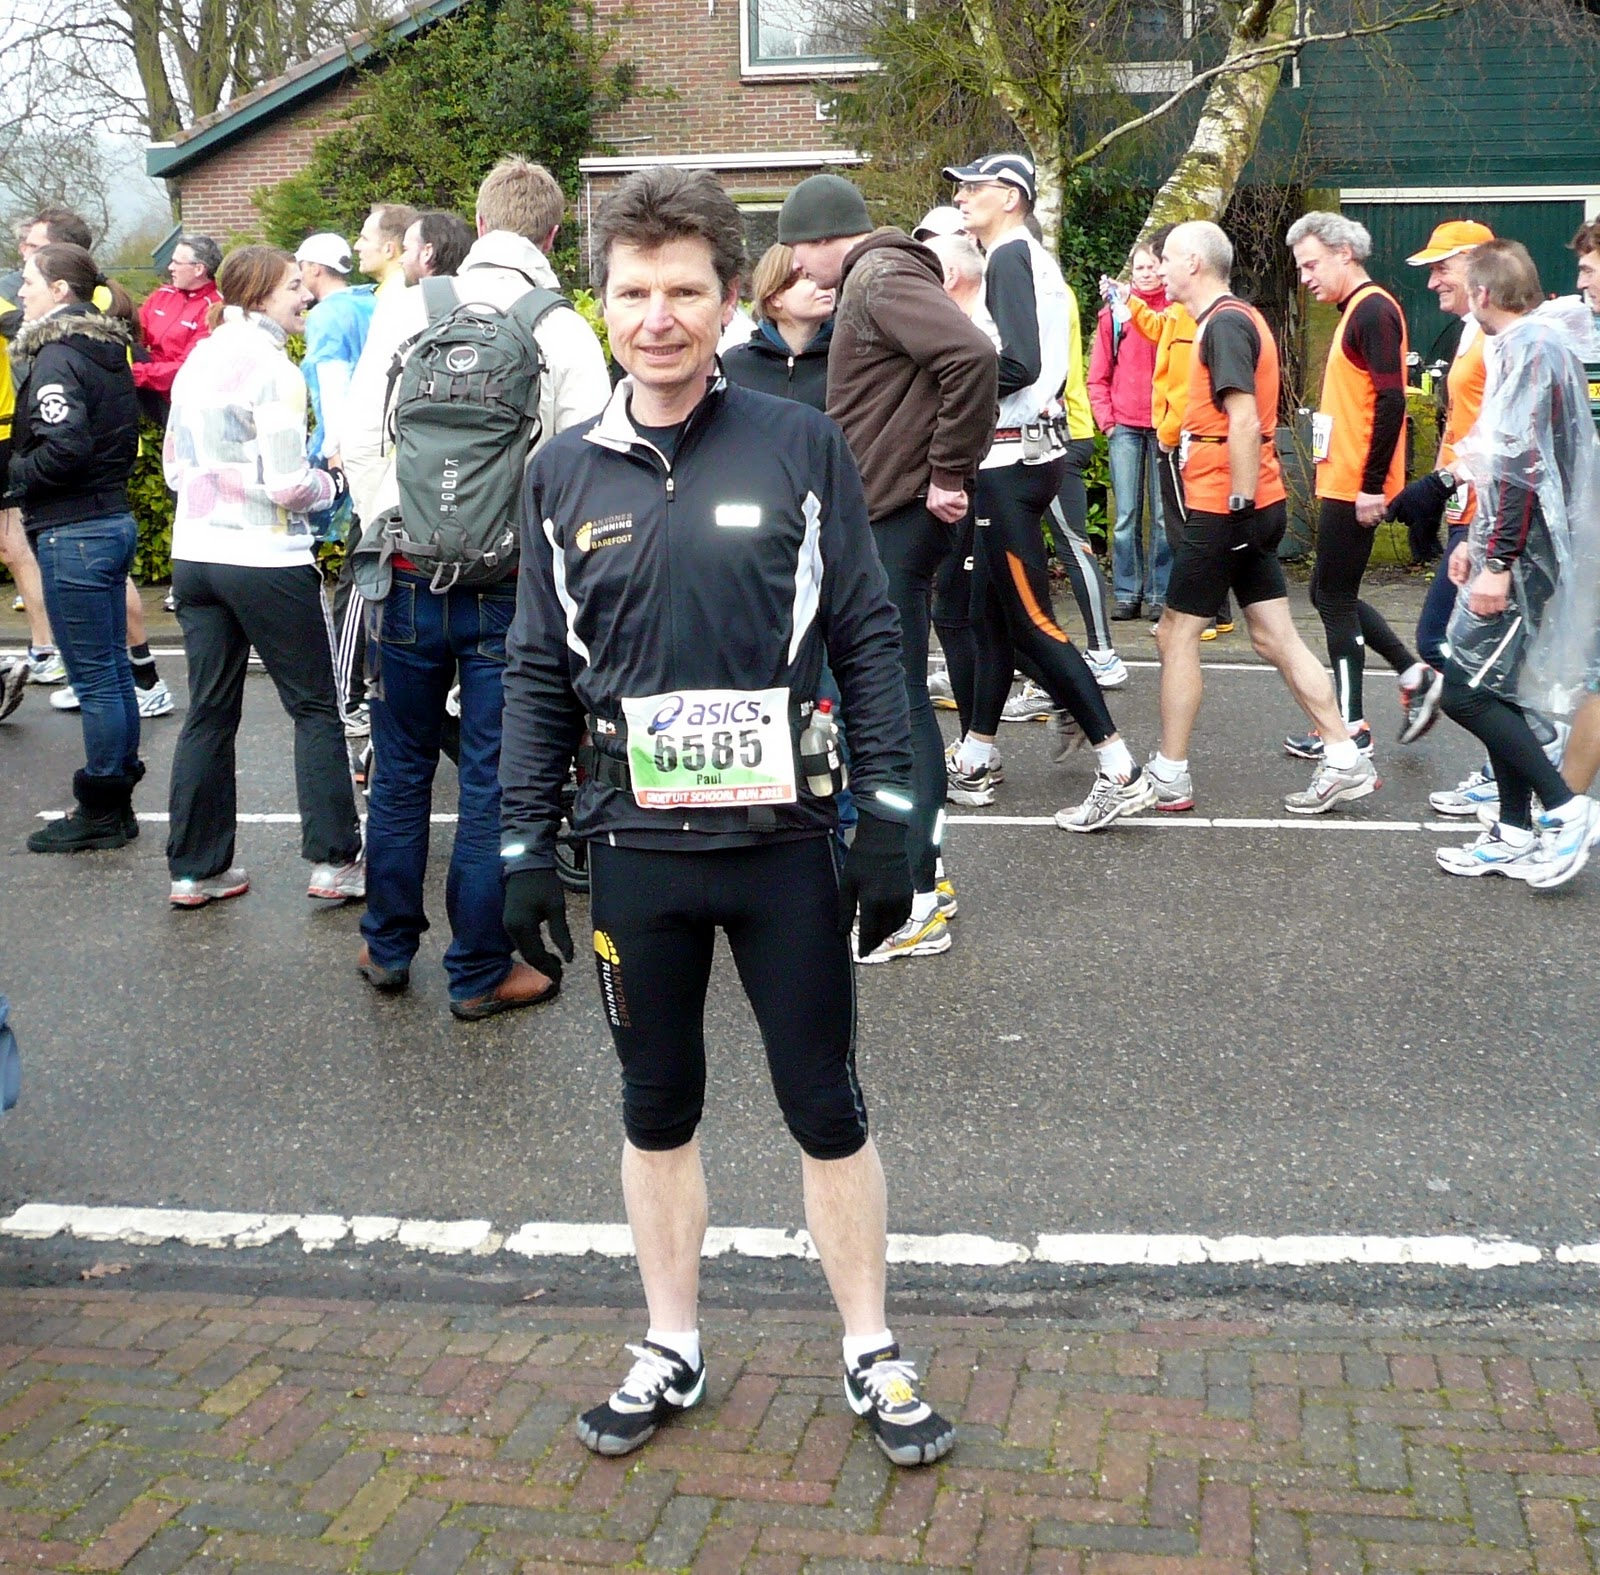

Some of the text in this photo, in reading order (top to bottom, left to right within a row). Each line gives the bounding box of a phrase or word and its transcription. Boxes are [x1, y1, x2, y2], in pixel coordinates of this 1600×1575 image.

[592, 520, 632, 535] RUNNING
[591, 534, 632, 549] BAREFOOT
[687, 700, 761, 726] asics
[654, 729, 763, 773] 6585
[696, 773, 722, 785] Paul
[672, 791, 689, 804] UIT
[690, 789, 735, 804] SCHOORL
[602, 962, 620, 1026] RUNNING
